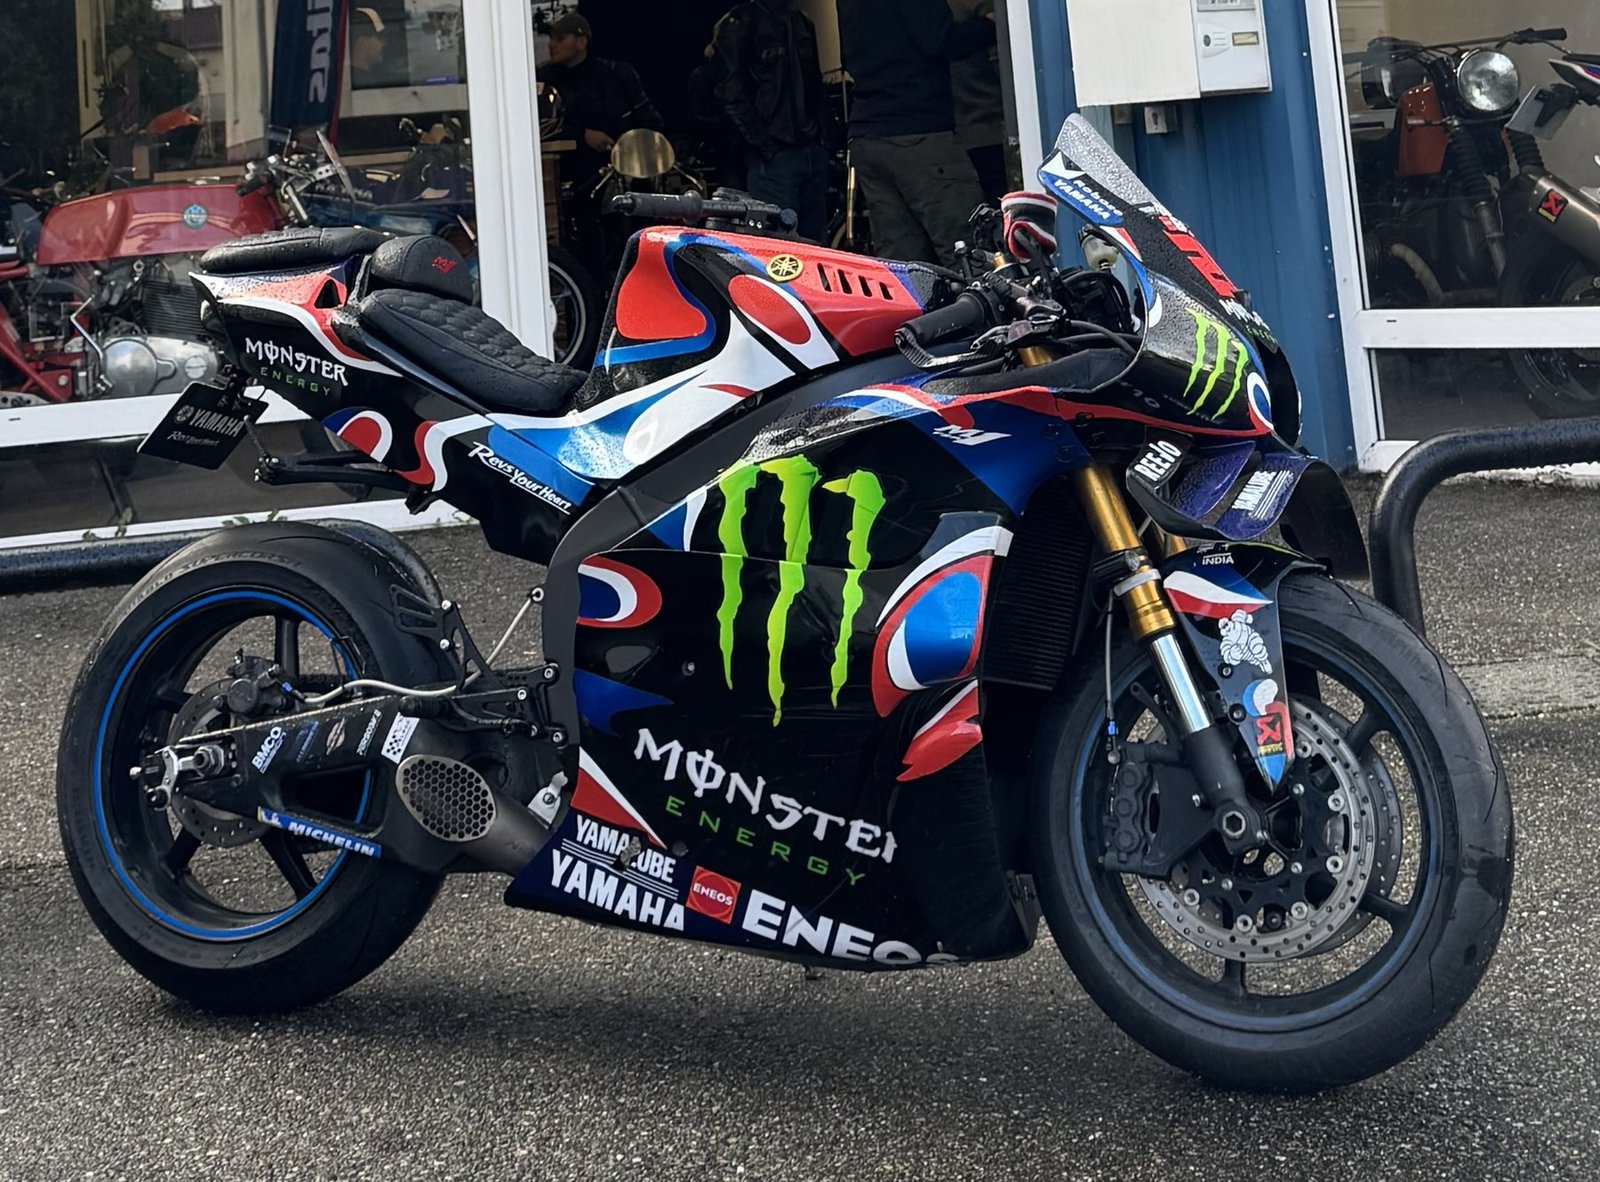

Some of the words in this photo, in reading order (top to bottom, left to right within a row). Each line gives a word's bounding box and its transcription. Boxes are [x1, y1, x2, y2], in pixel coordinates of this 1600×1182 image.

[245, 337, 348, 387] MONSTER
[260, 366, 331, 396] ENERGY
[189, 408, 245, 438] YAMAHA
[1202, 555, 1235, 566] INDIA
[287, 820, 375, 857] MICHELIN
[576, 814, 677, 884] YAMAUBE
[665, 796, 866, 887] ENERGY
[550, 850, 685, 931] YAMAHA
[693, 882, 734, 907] ENEOS
